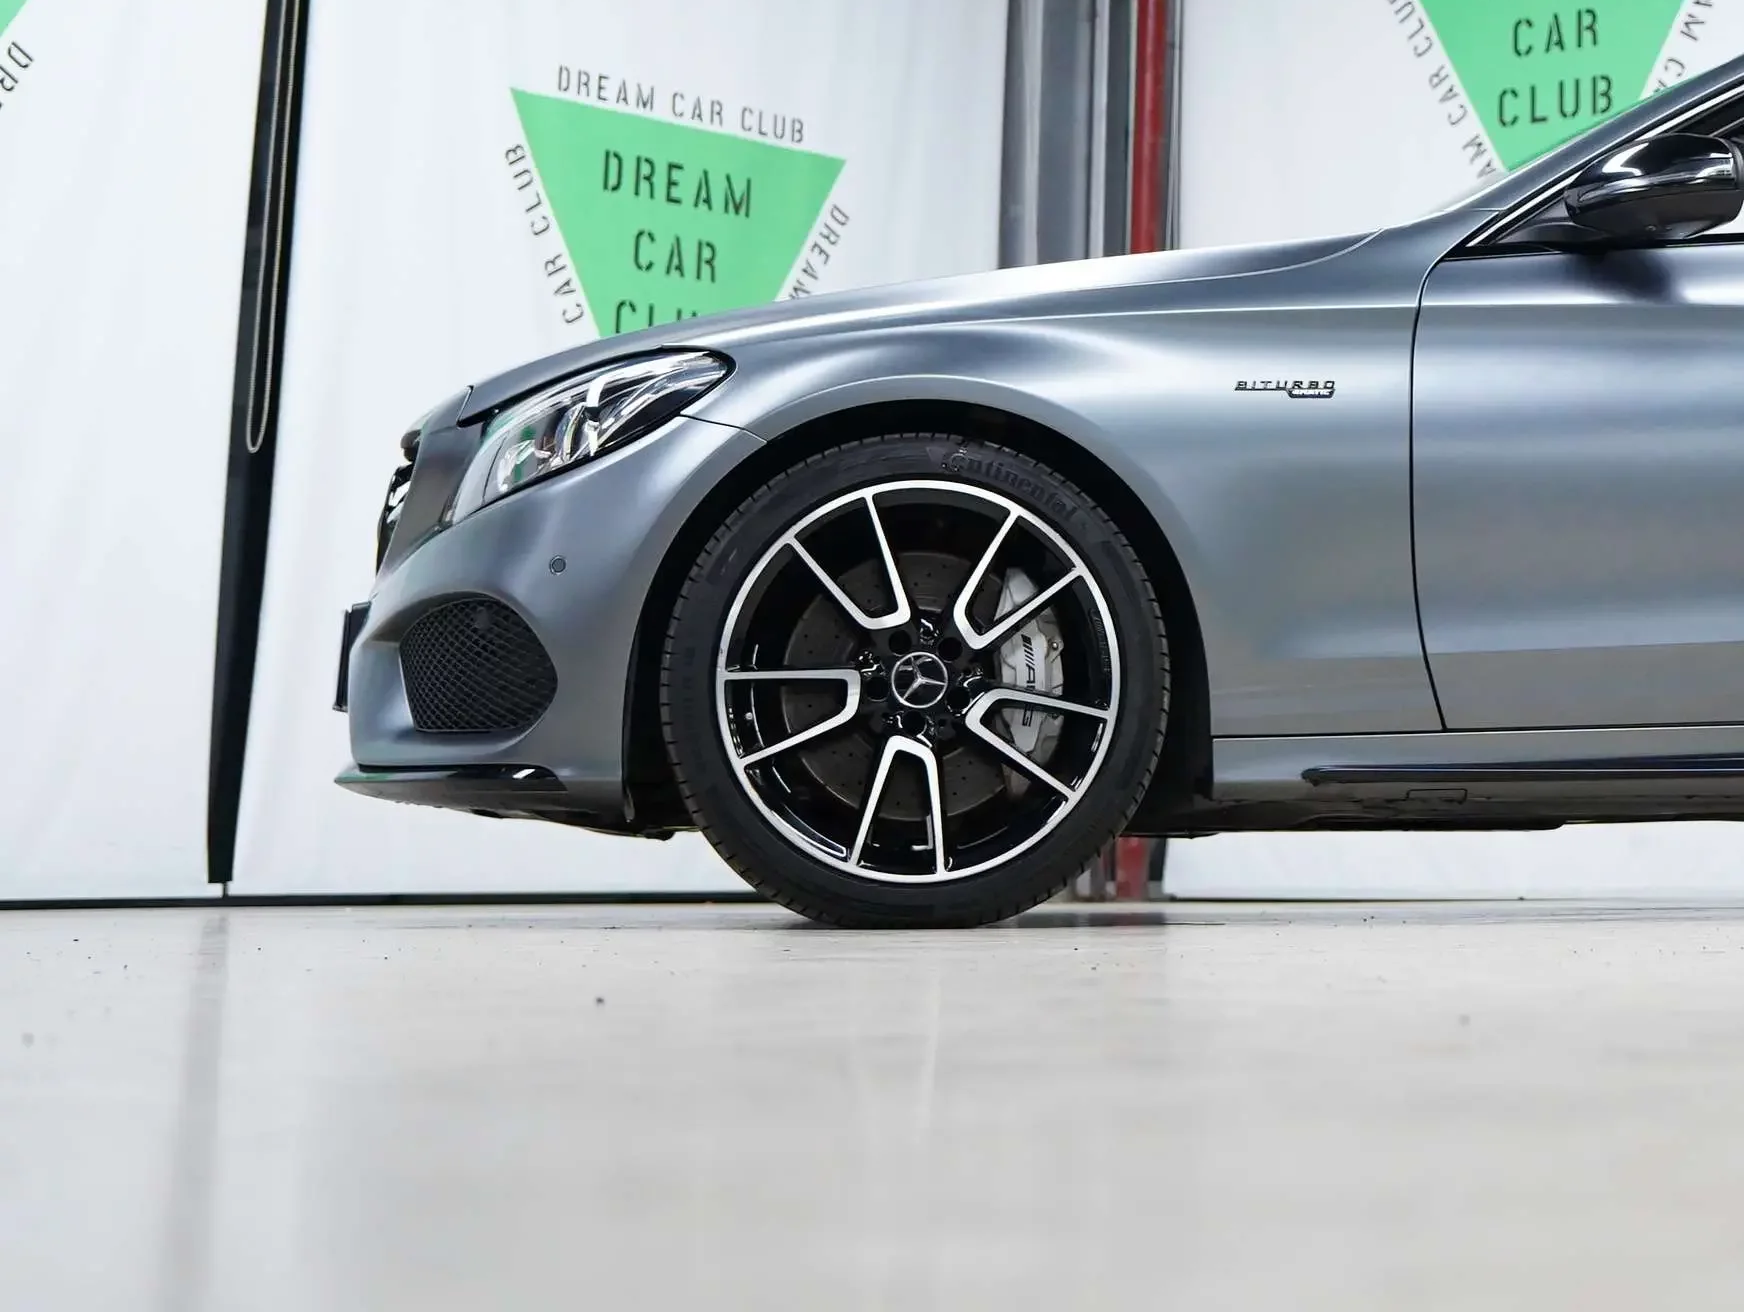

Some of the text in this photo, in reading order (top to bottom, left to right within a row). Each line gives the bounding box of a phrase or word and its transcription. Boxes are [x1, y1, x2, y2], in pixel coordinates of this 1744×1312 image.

[1513, 8, 1599, 57] CAR
[557, 64, 805, 144] DREAM CAR CLUB
[1427, 64, 1469, 127] CAR
[1498, 74, 1614, 127] CLUB
[602, 148, 752, 219] DREAM
[504, 143, 585, 325] CAR CLUB
[633, 229, 718, 284] CAR
[1236, 380, 1336, 390] BITURBO
